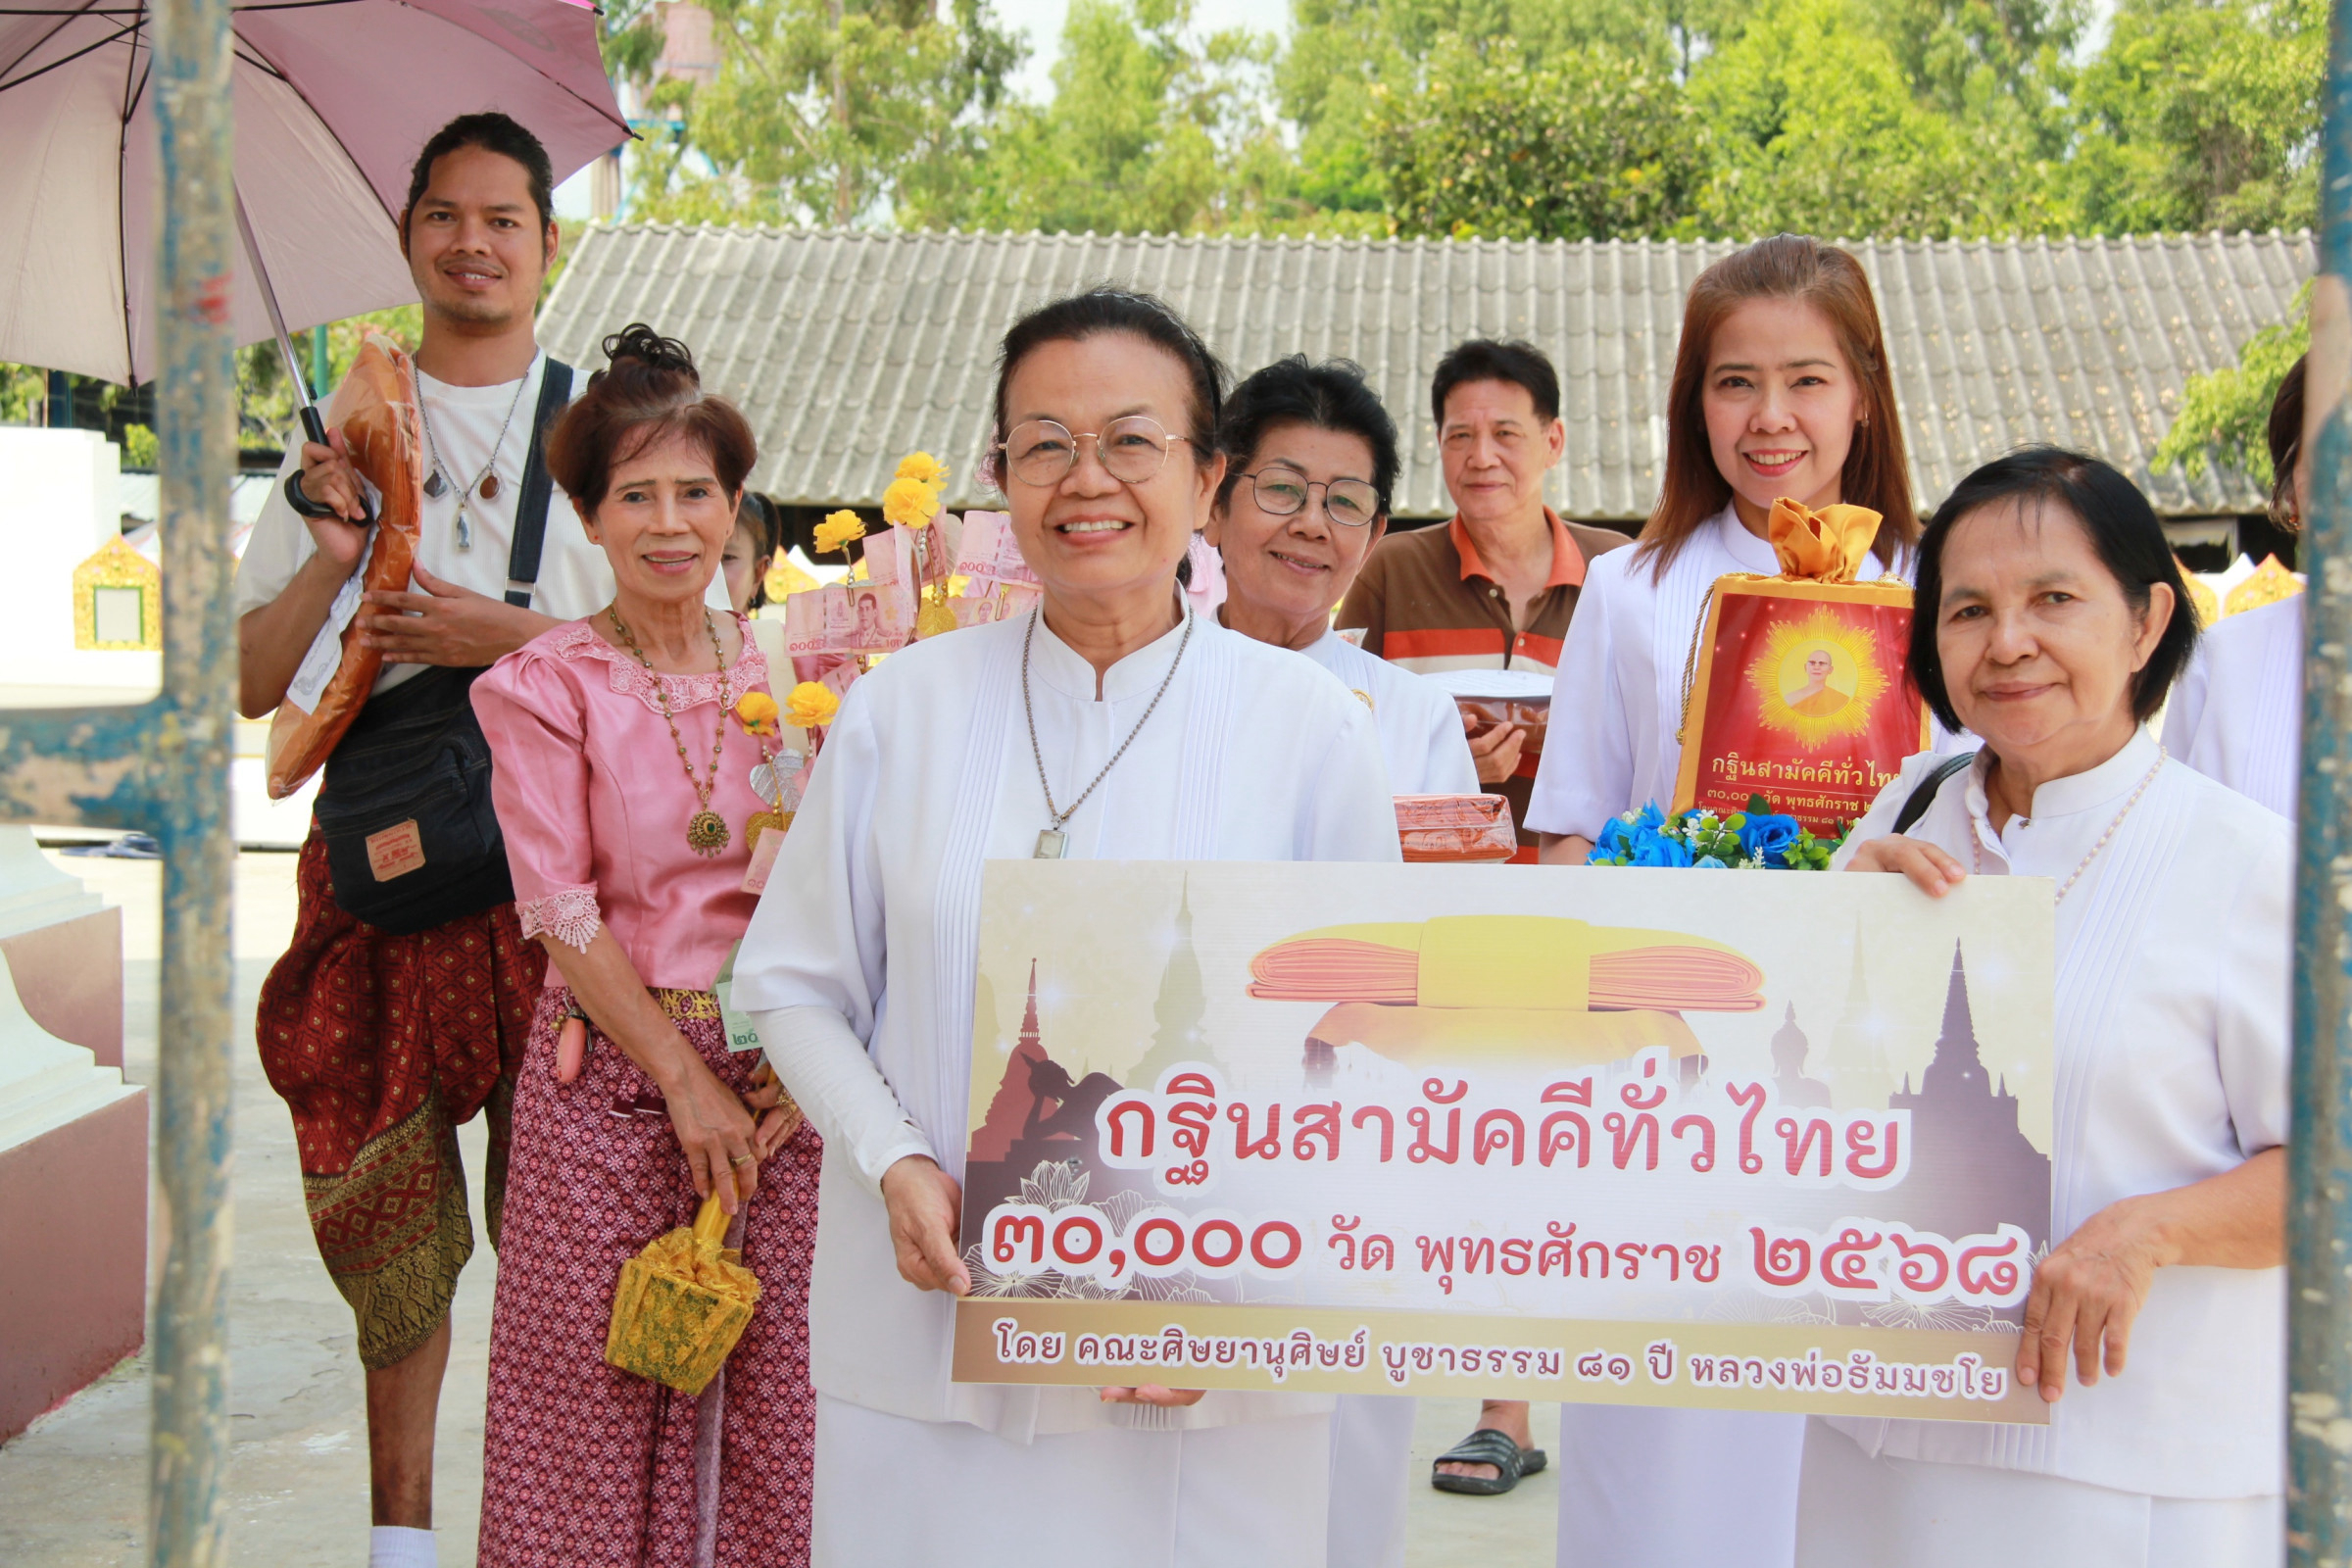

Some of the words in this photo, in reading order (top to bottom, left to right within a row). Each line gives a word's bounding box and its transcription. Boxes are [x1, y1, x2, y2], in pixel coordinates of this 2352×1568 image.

[1707, 789, 1749, 801] ๓๐,๐๐
[1786, 795, 1859, 810] พุทธศักราช
[1105, 1057, 1898, 1186] กฐินสามัคคีทั่วไทย
[993, 1214, 1301, 1278] ๓๐,๐๐๐
[1327, 1213, 1395, 1271] วัด
[1415, 1220, 1722, 1295] พุทธศักราช
[1748, 1226, 2019, 1296] ๒๕๖๘
[997, 1322, 1061, 1359] โดย
[1078, 1328, 1365, 1378] คณะศิษยานุศิษย์
[1382, 1345, 1559, 1382] บูชาธรรม
[1578, 1350, 1631, 1381] ๘๑
[1648, 1343, 1673, 1380] ปี
[1691, 1352, 2003, 1395] หลวงพ่อธัมมชโย
